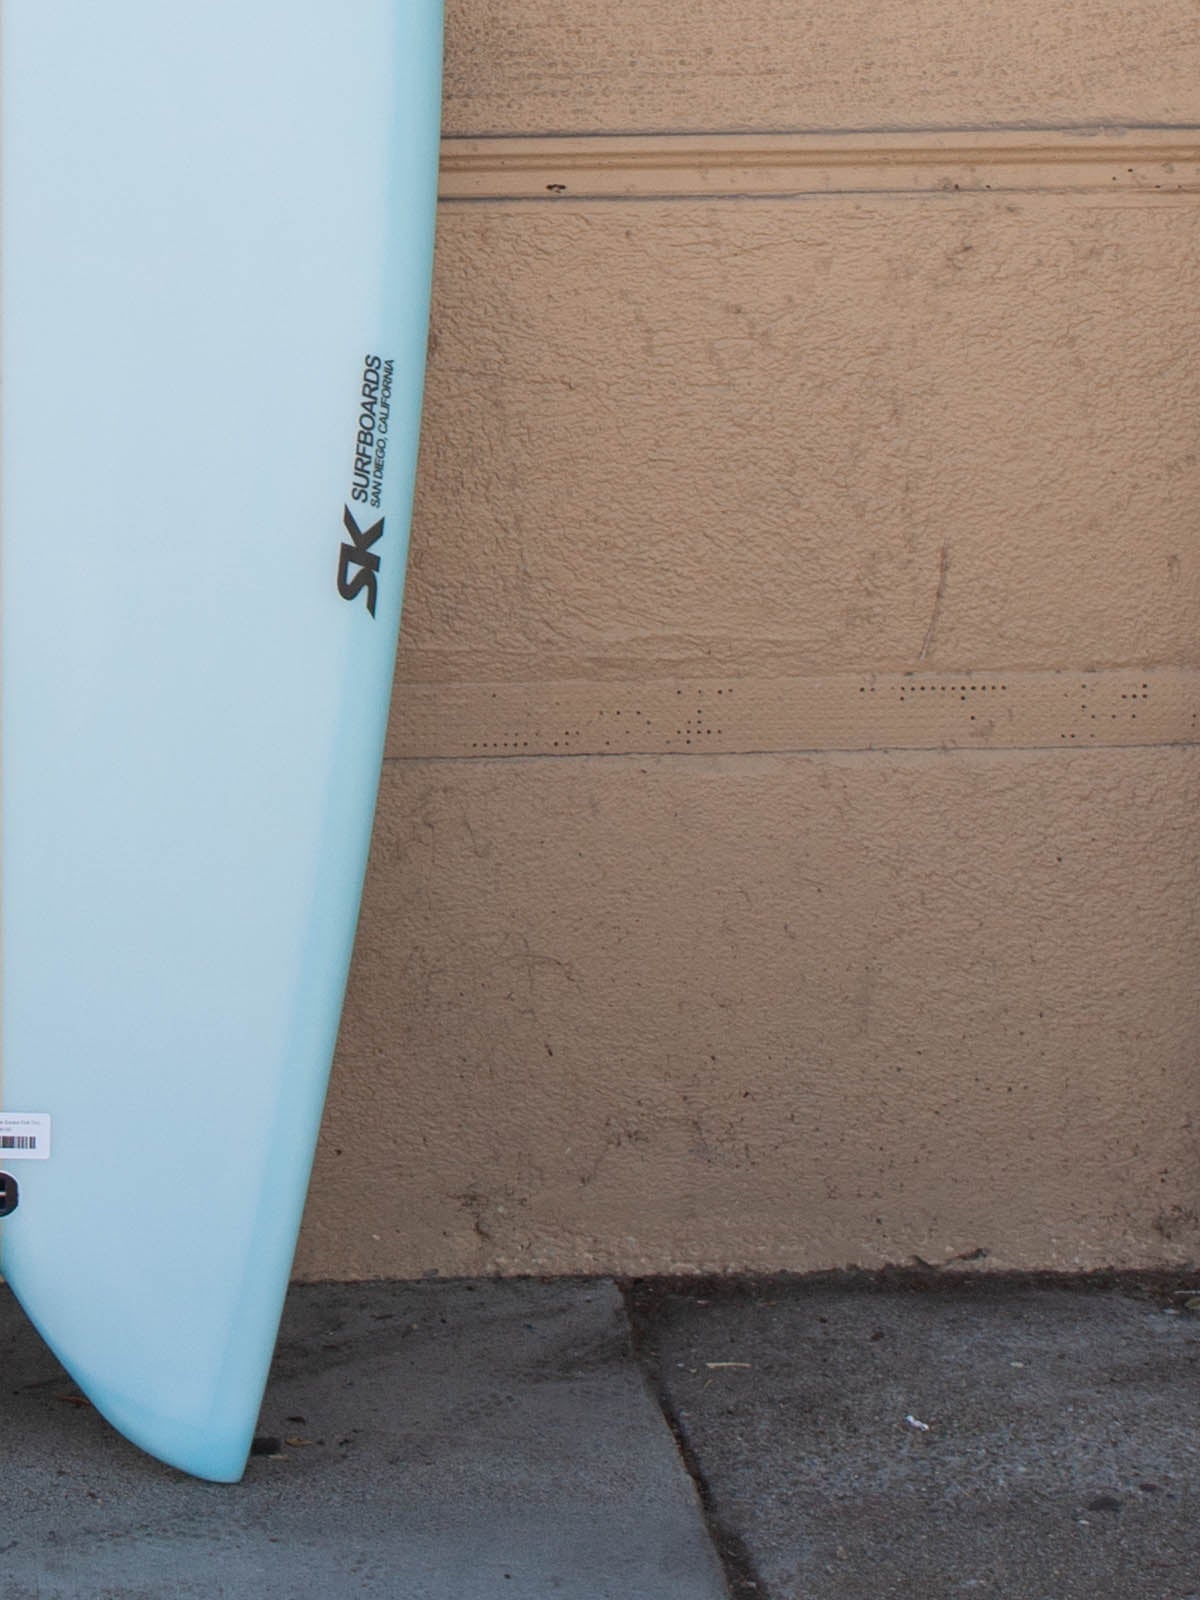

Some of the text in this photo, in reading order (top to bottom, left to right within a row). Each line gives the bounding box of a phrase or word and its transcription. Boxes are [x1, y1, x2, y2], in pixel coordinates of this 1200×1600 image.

[352, 355, 381, 503] SURFBOARDS
[370, 359, 394, 508] SAN DIEGO, CALIFORNIA
[337, 504, 385, 619] SK
